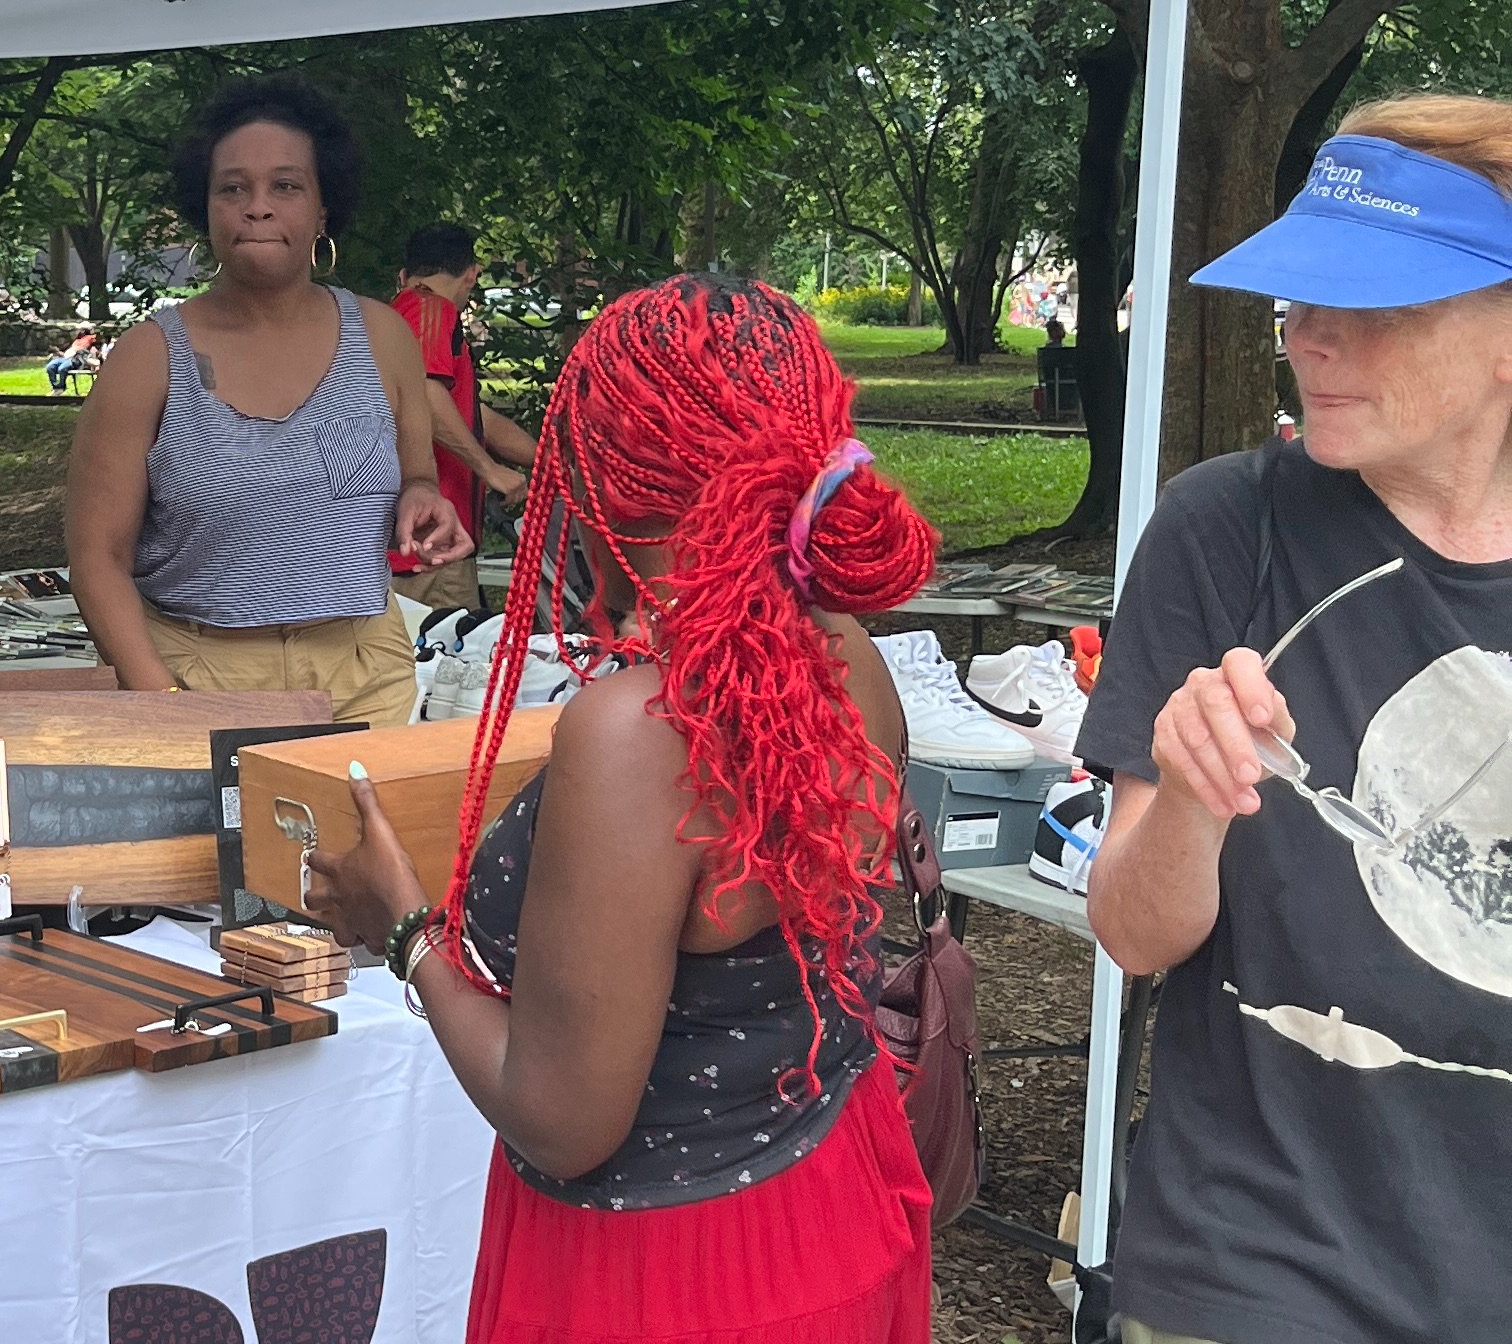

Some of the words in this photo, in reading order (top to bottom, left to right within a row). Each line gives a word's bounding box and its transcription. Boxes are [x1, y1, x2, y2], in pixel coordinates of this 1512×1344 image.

[1320, 156, 1363, 185] Penn
[1333, 184, 1349, 200] &
[1348, 187, 1421, 217] Sciences
